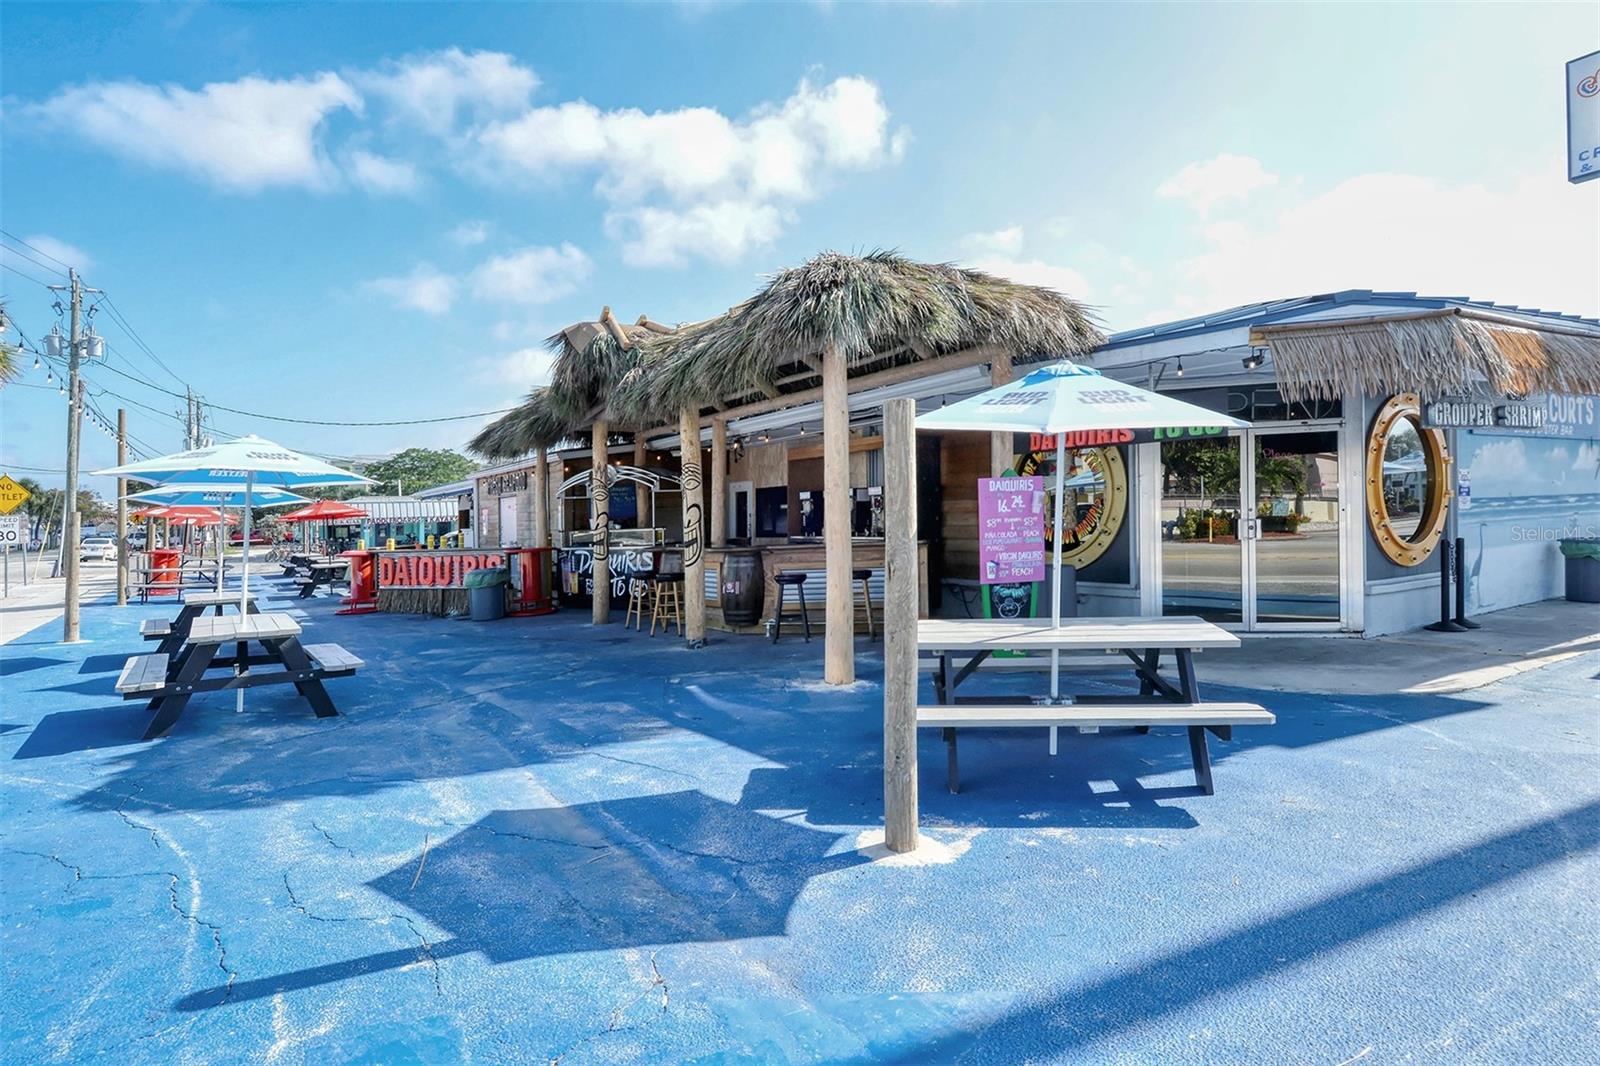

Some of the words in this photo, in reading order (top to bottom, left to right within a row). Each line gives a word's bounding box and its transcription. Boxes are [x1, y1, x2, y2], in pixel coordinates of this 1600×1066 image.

[1078, 389, 1131, 397] BUD
[1077, 395, 1147, 404] LIGHT
[1435, 402, 1493, 426] GROUPER
[1504, 405, 1548, 427] SHRIMP
[990, 479, 1034, 491] DAIQUIRIS
[1, 493, 24, 501] TLET
[610, 576, 626, 599] TO
